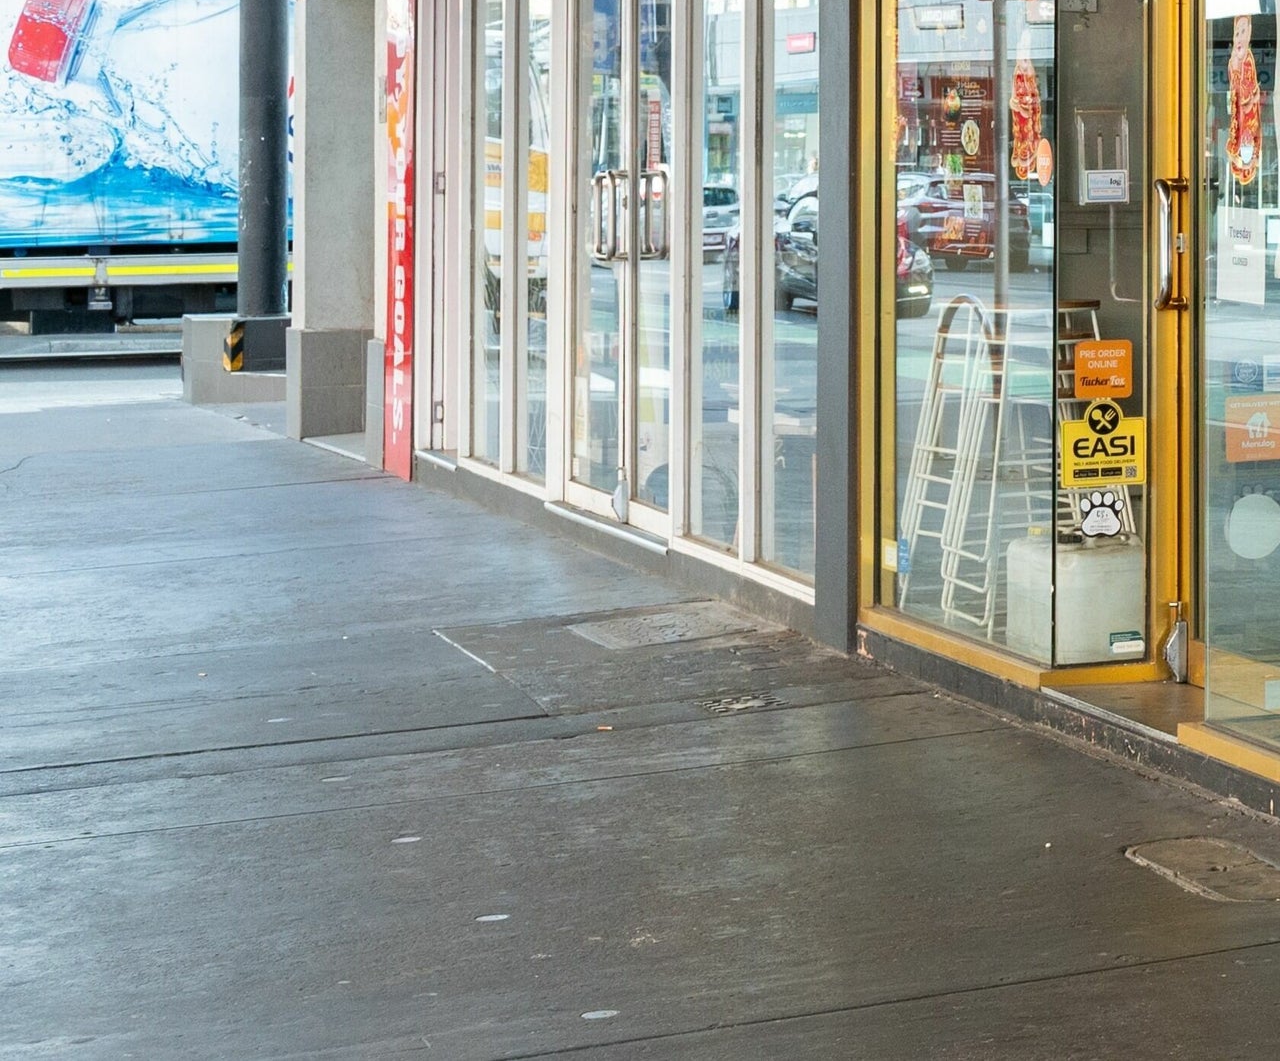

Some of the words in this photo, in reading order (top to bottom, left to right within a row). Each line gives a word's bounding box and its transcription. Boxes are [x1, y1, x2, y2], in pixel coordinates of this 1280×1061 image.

[1229, 225, 1252, 243] Tuesday
[1080, 350, 1096, 358] PRE
[1098, 349, 1126, 357] ORDER
[1088, 360, 1118, 369] ONLINE
[1073, 435, 1135, 458] EASI
[1242, 439, 1276, 449] Menulog
